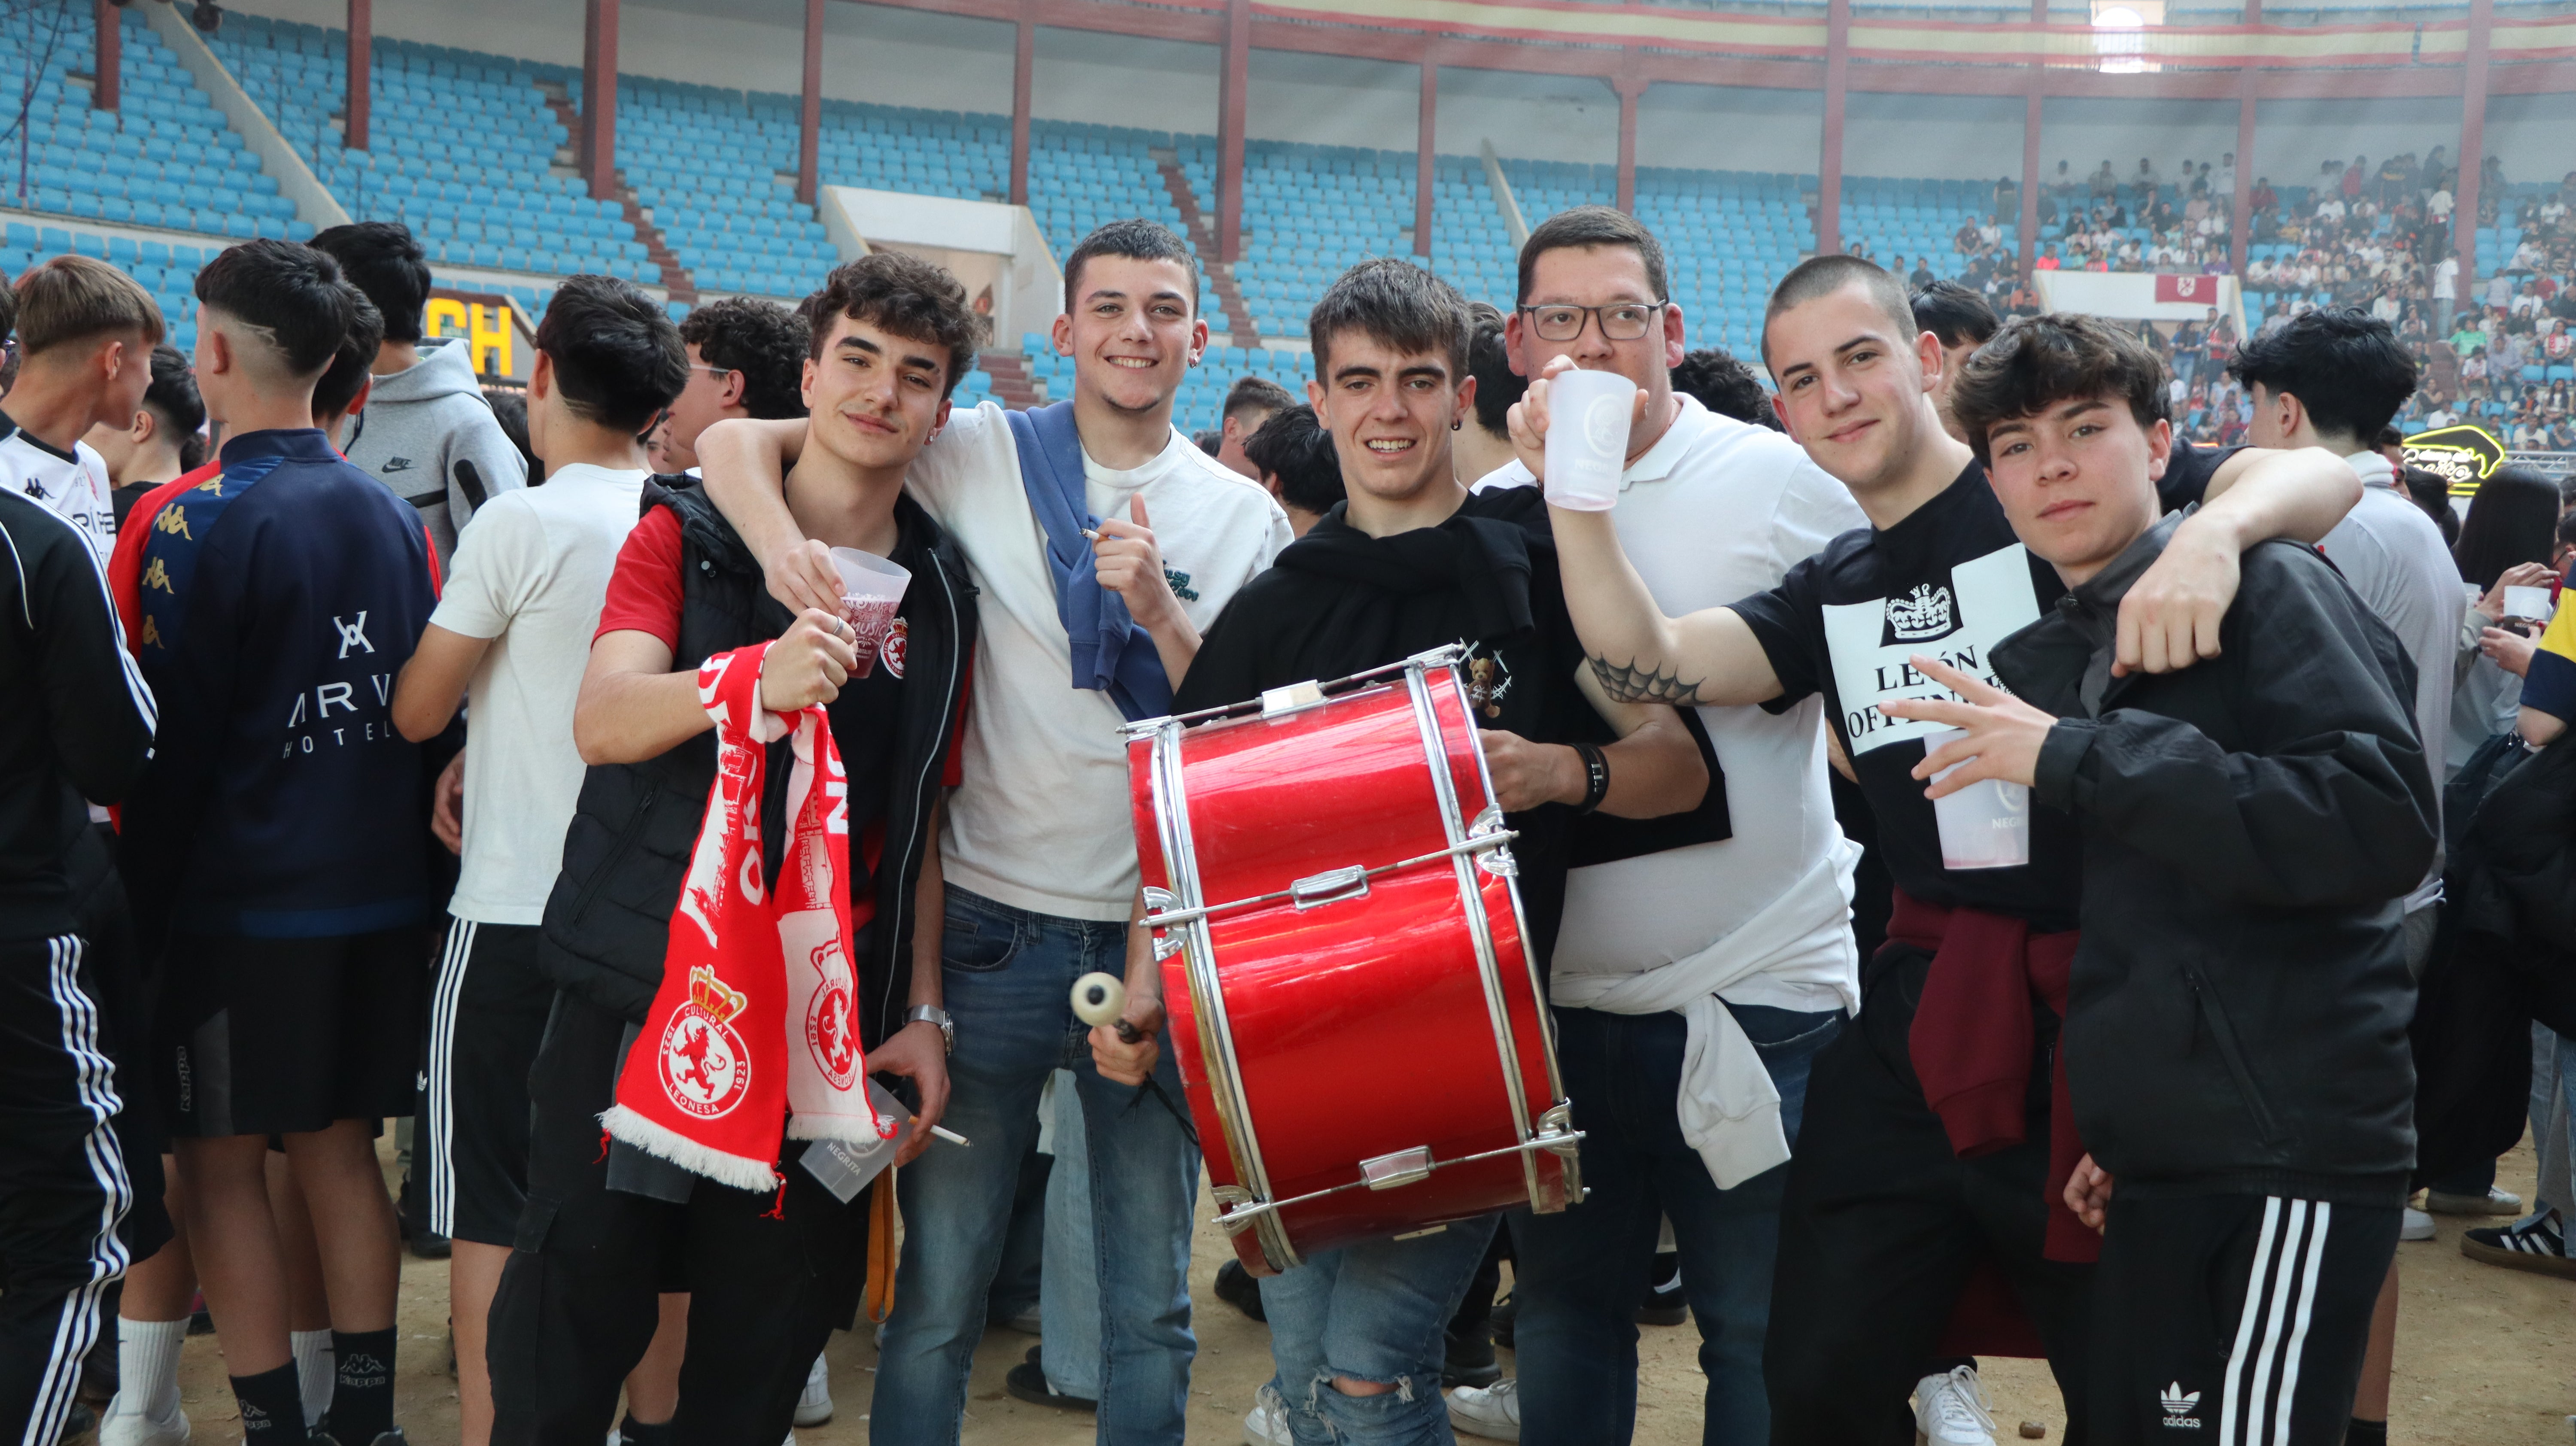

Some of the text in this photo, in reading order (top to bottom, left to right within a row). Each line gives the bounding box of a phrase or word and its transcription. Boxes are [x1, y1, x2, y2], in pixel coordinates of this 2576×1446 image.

[850, 620, 886, 637] MUSIC
[685, 1005, 729, 1039] CULTURAL
[663, 1025, 675, 1055] 1923
[734, 1060, 746, 1090] 1923
[668, 1082, 720, 1114] LEONESA
[827, 1142, 862, 1176] NEGRITA
[340, 1374, 386, 1387] Kappa
[2163, 1415, 2201, 1428] adidas
